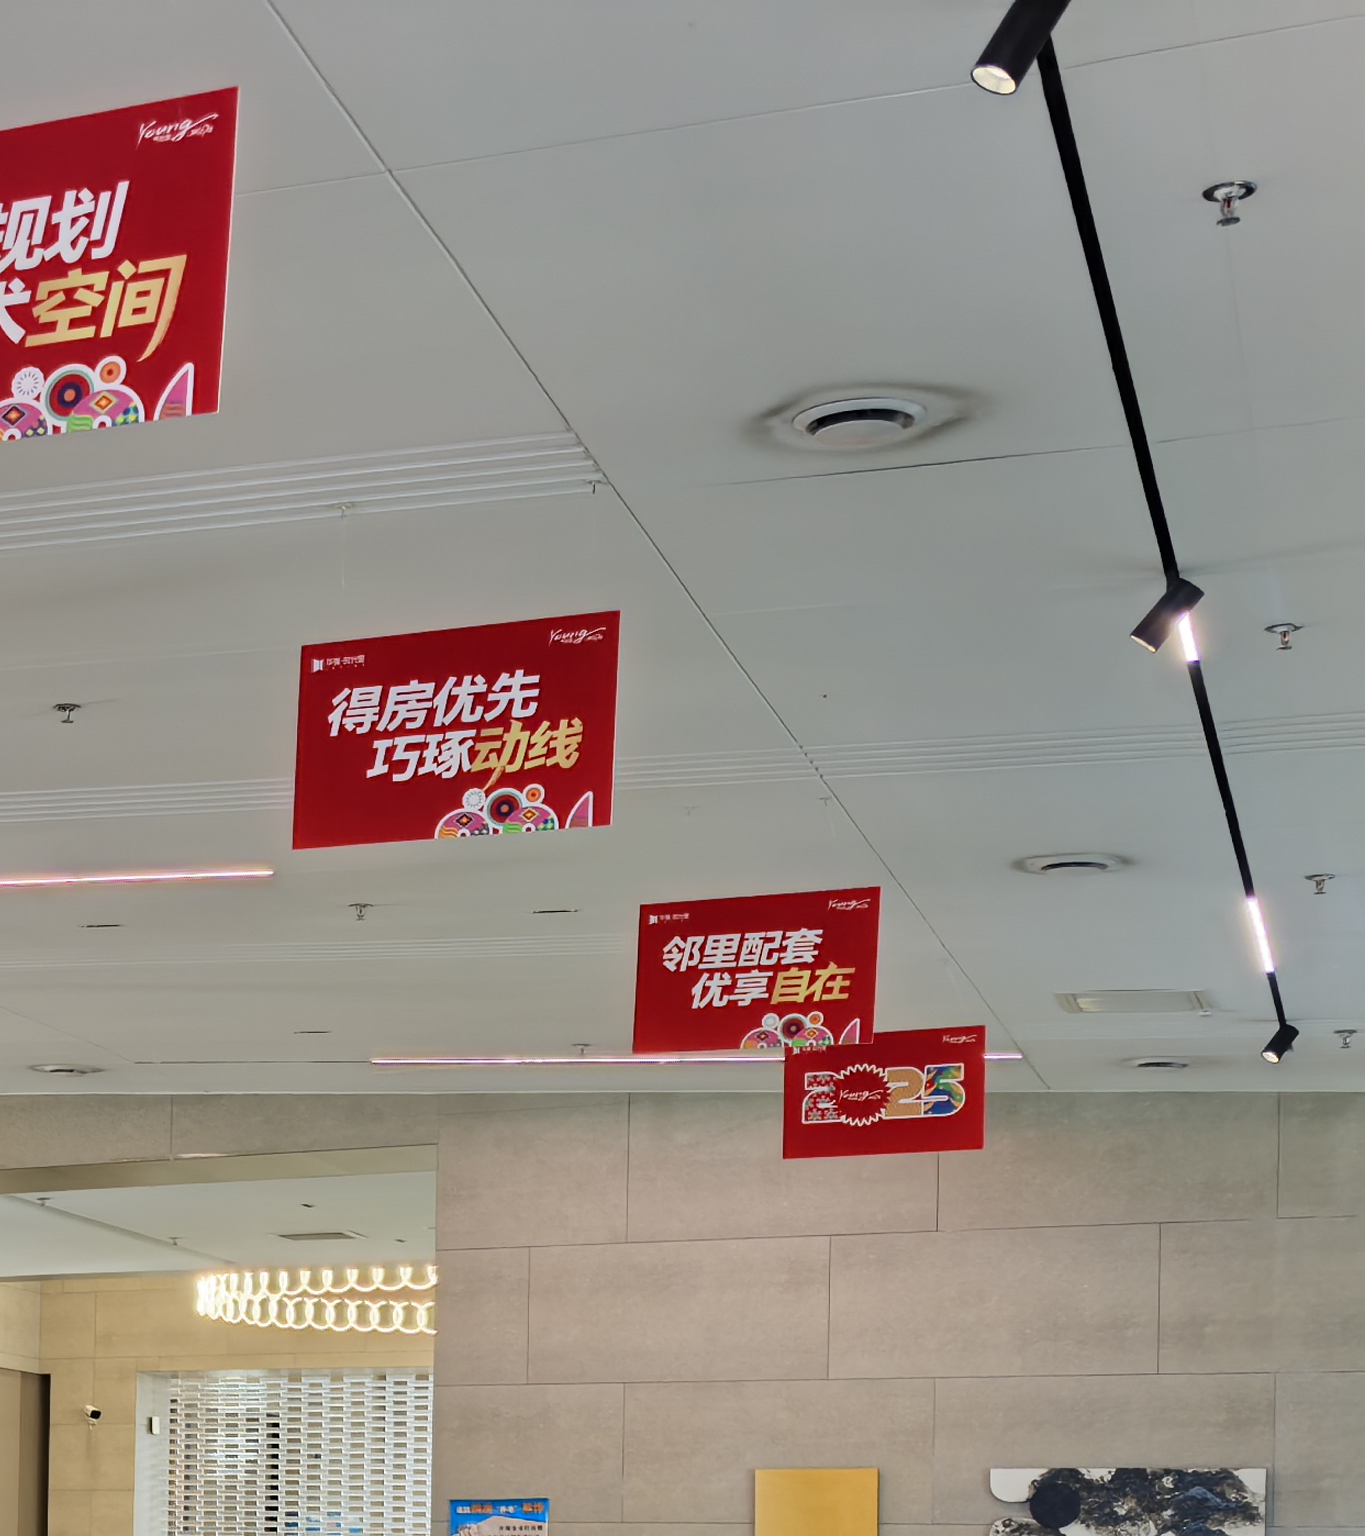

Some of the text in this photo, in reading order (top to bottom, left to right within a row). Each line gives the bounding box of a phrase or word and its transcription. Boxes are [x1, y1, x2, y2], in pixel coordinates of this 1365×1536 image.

[328, 669, 540, 737] 得房优先
[366, 717, 584, 791] 巧琢动线
[662, 928, 823, 972] 邻里配套
[691, 961, 856, 1009] 优享自在
[801, 1063, 966, 1126] 2025
